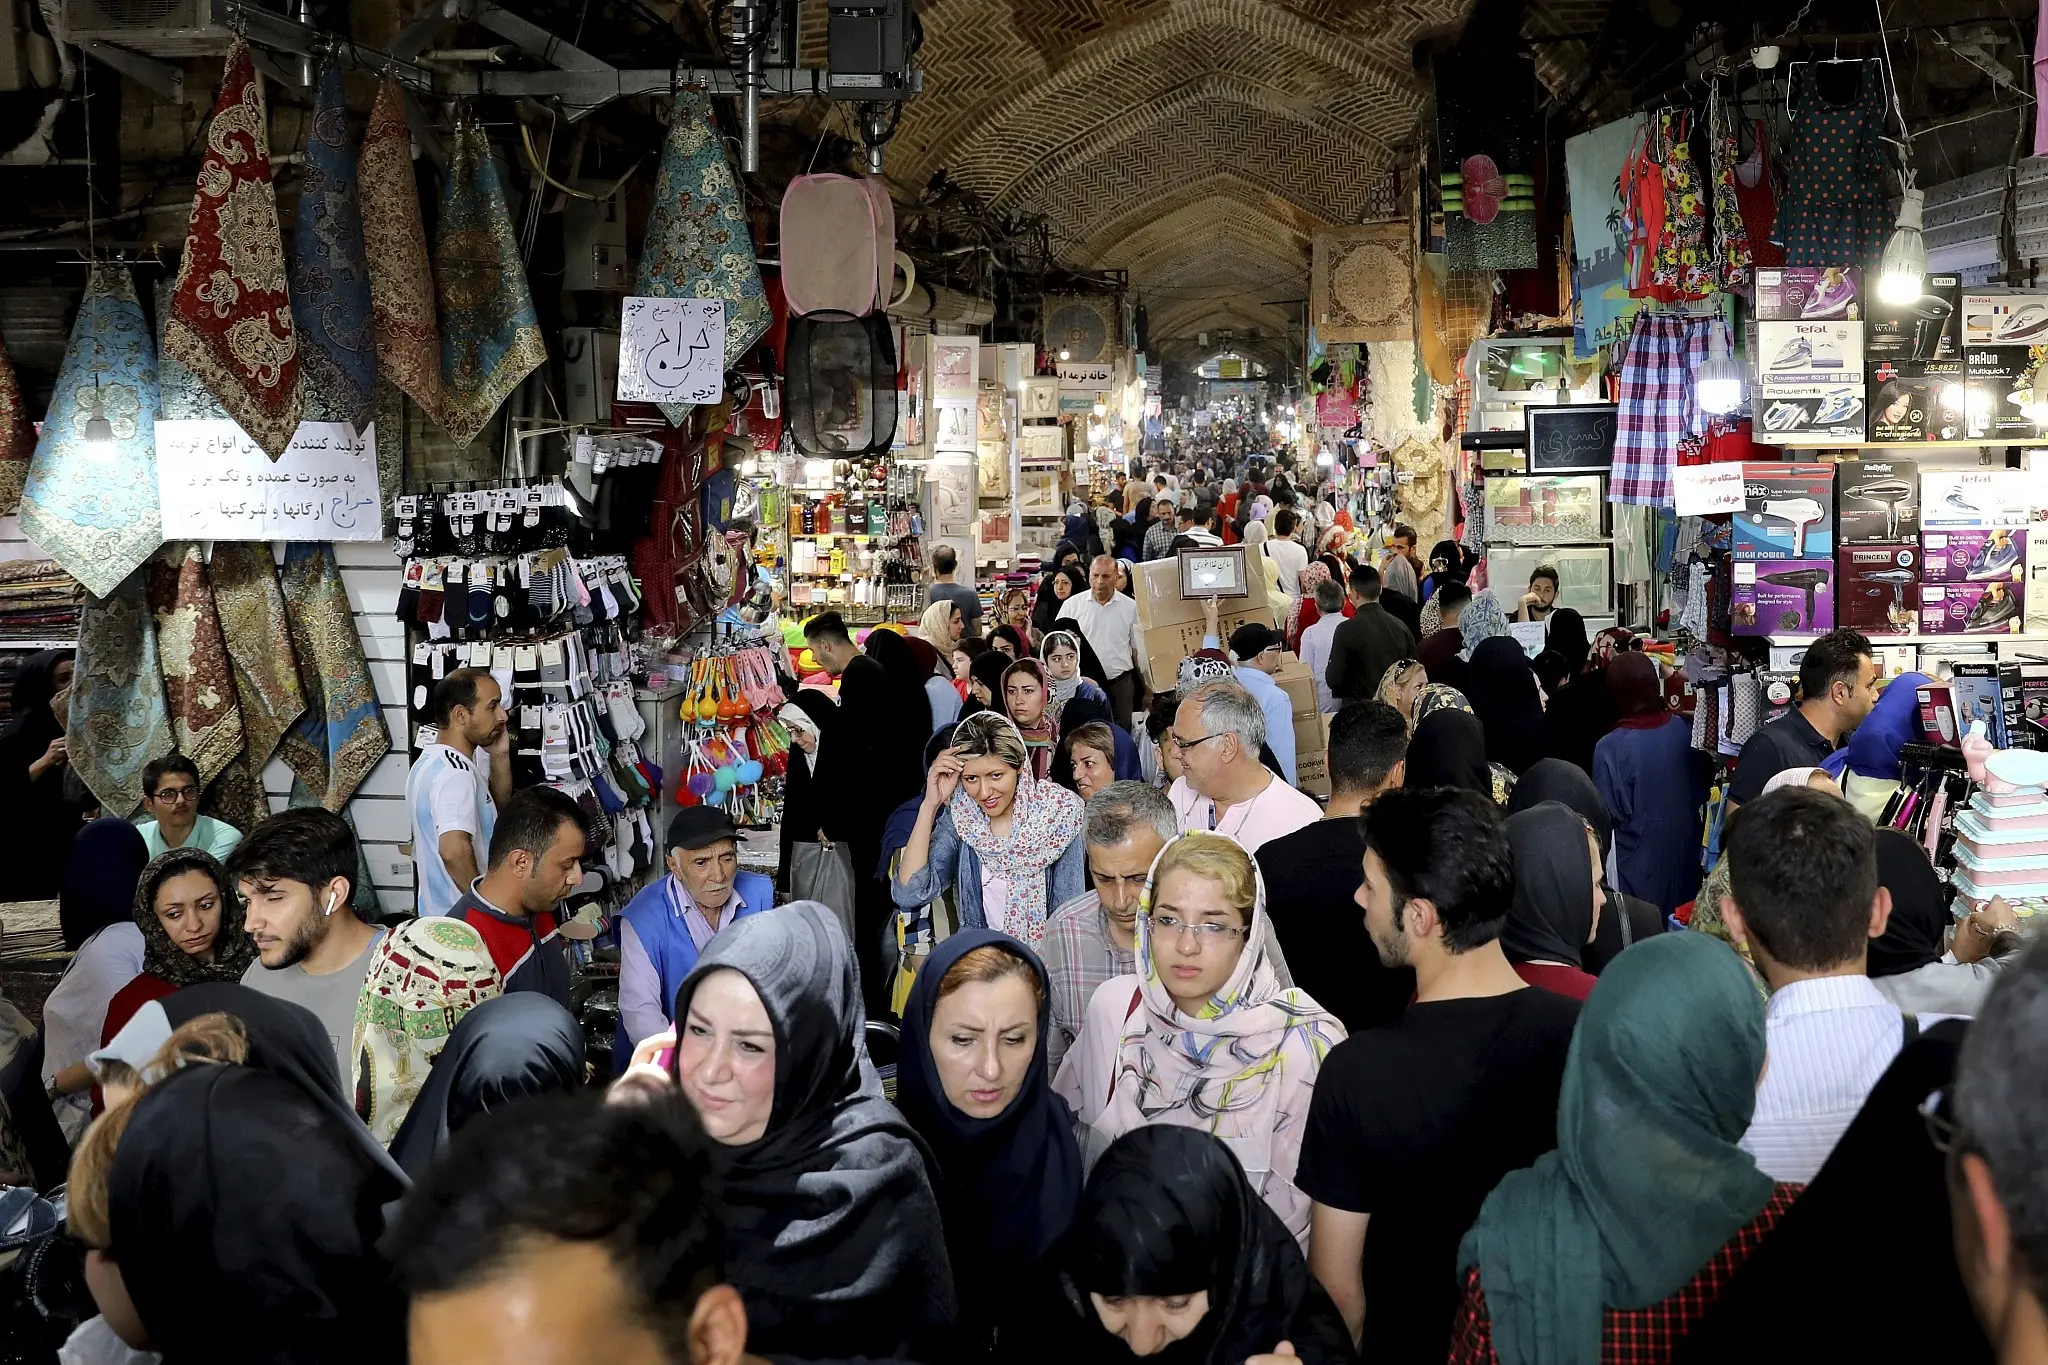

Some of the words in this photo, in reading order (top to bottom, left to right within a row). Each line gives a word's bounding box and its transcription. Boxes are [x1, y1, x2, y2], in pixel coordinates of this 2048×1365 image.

[1795, 325, 1828, 334] Tefal
[645, 320, 710, 388] حراج
[1969, 352, 1998, 365] BRAUN
[1069, 370, 1087, 383] ترمه
[1089, 370, 1108, 380] خانه
[1968, 368, 2005, 376] Multiquick
[1875, 430, 1922, 438] Professional
[206, 436, 236, 454] انواع
[292, 437, 328, 450] کننده
[333, 439, 366, 456] تولید
[246, 475, 253, 487] و
[257, 473, 292, 483] عمده
[295, 473, 339, 488] صورت
[343, 473, 356, 488] به
[219, 501, 267, 520] شرکتها
[283, 502, 324, 519] ارگانها
[331, 490, 373, 528] حراج
[1961, 667, 1989, 675] Panasonic
